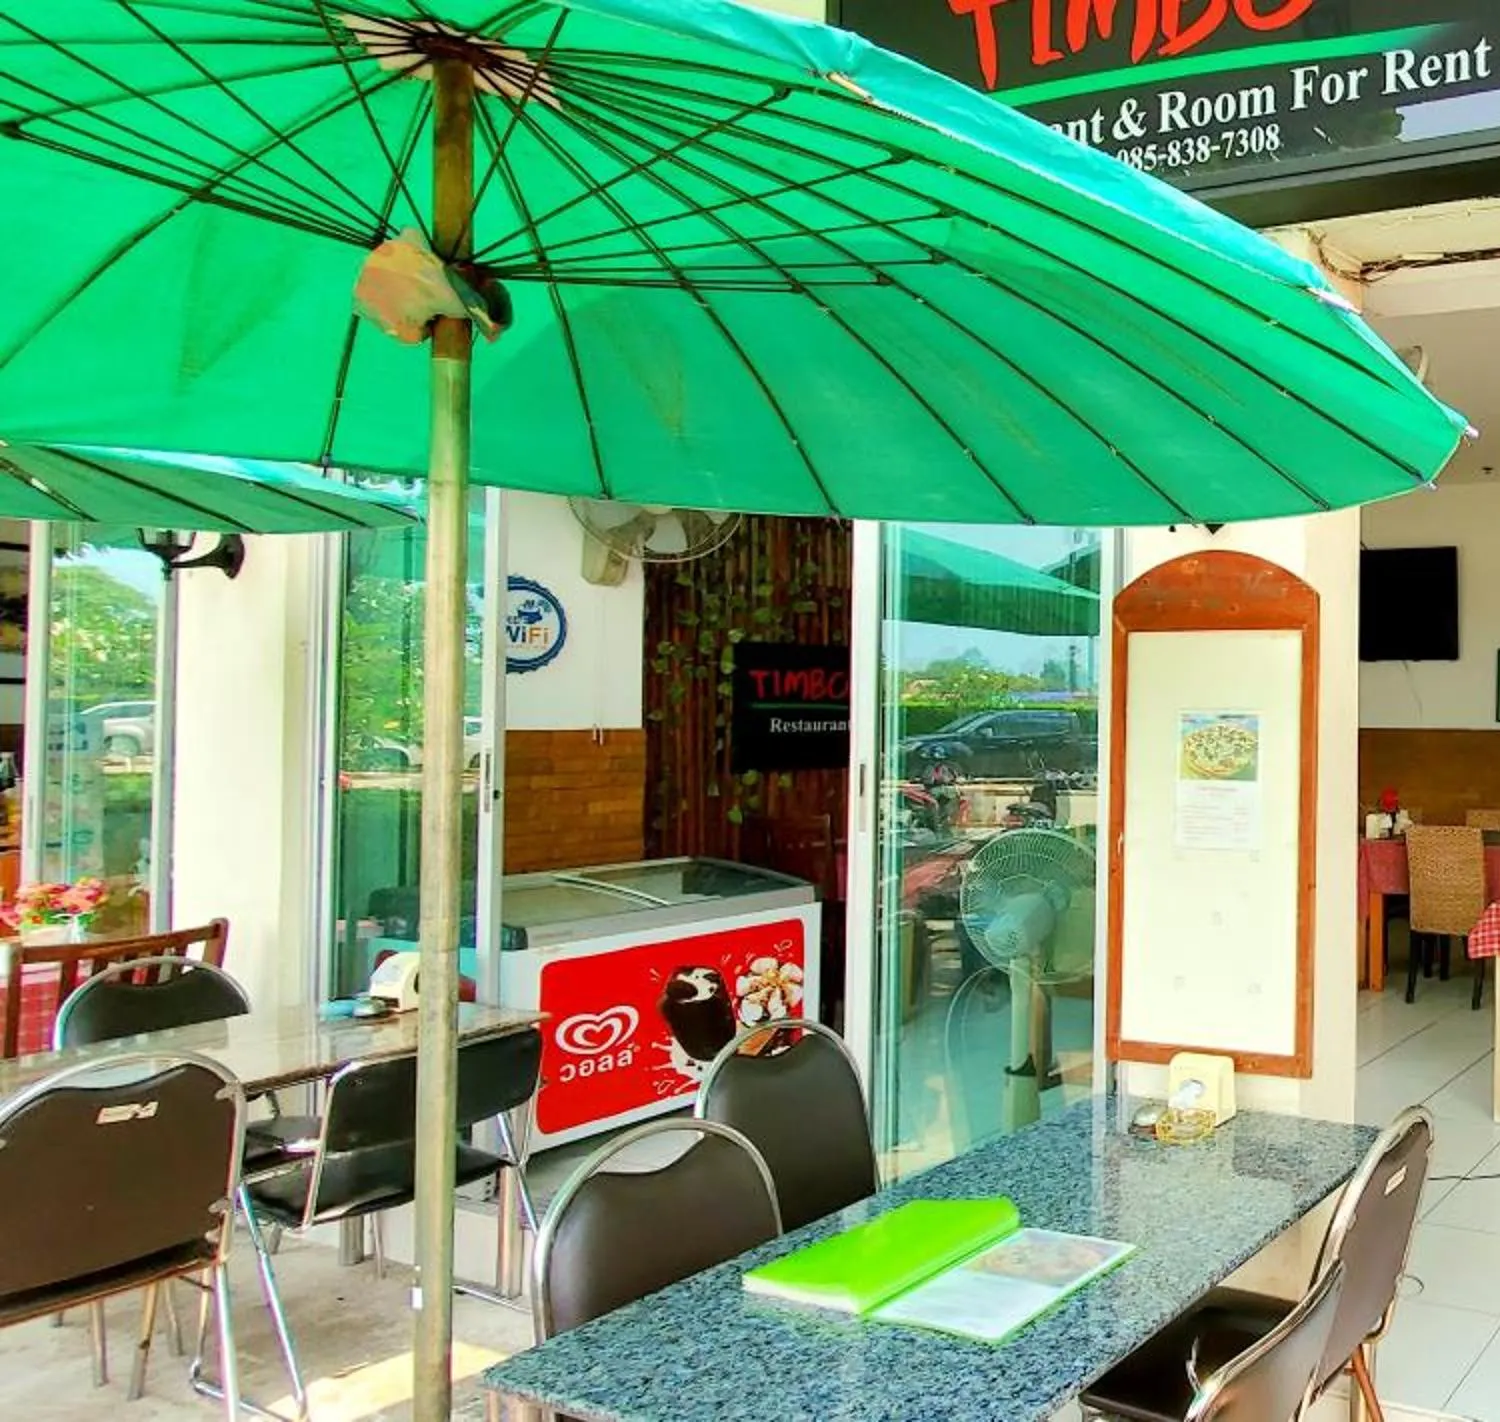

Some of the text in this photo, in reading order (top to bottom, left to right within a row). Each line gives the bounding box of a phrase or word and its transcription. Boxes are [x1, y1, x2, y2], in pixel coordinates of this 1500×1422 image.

[1112, 98, 1147, 141] &
[1157, 83, 1277, 133] Room
[1289, 64, 1369, 111] For
[1380, 36, 1493, 95] Rent
[1116, 122, 1281, 172] 085-838-7308
[559, 1041, 641, 1083] วอลล์
